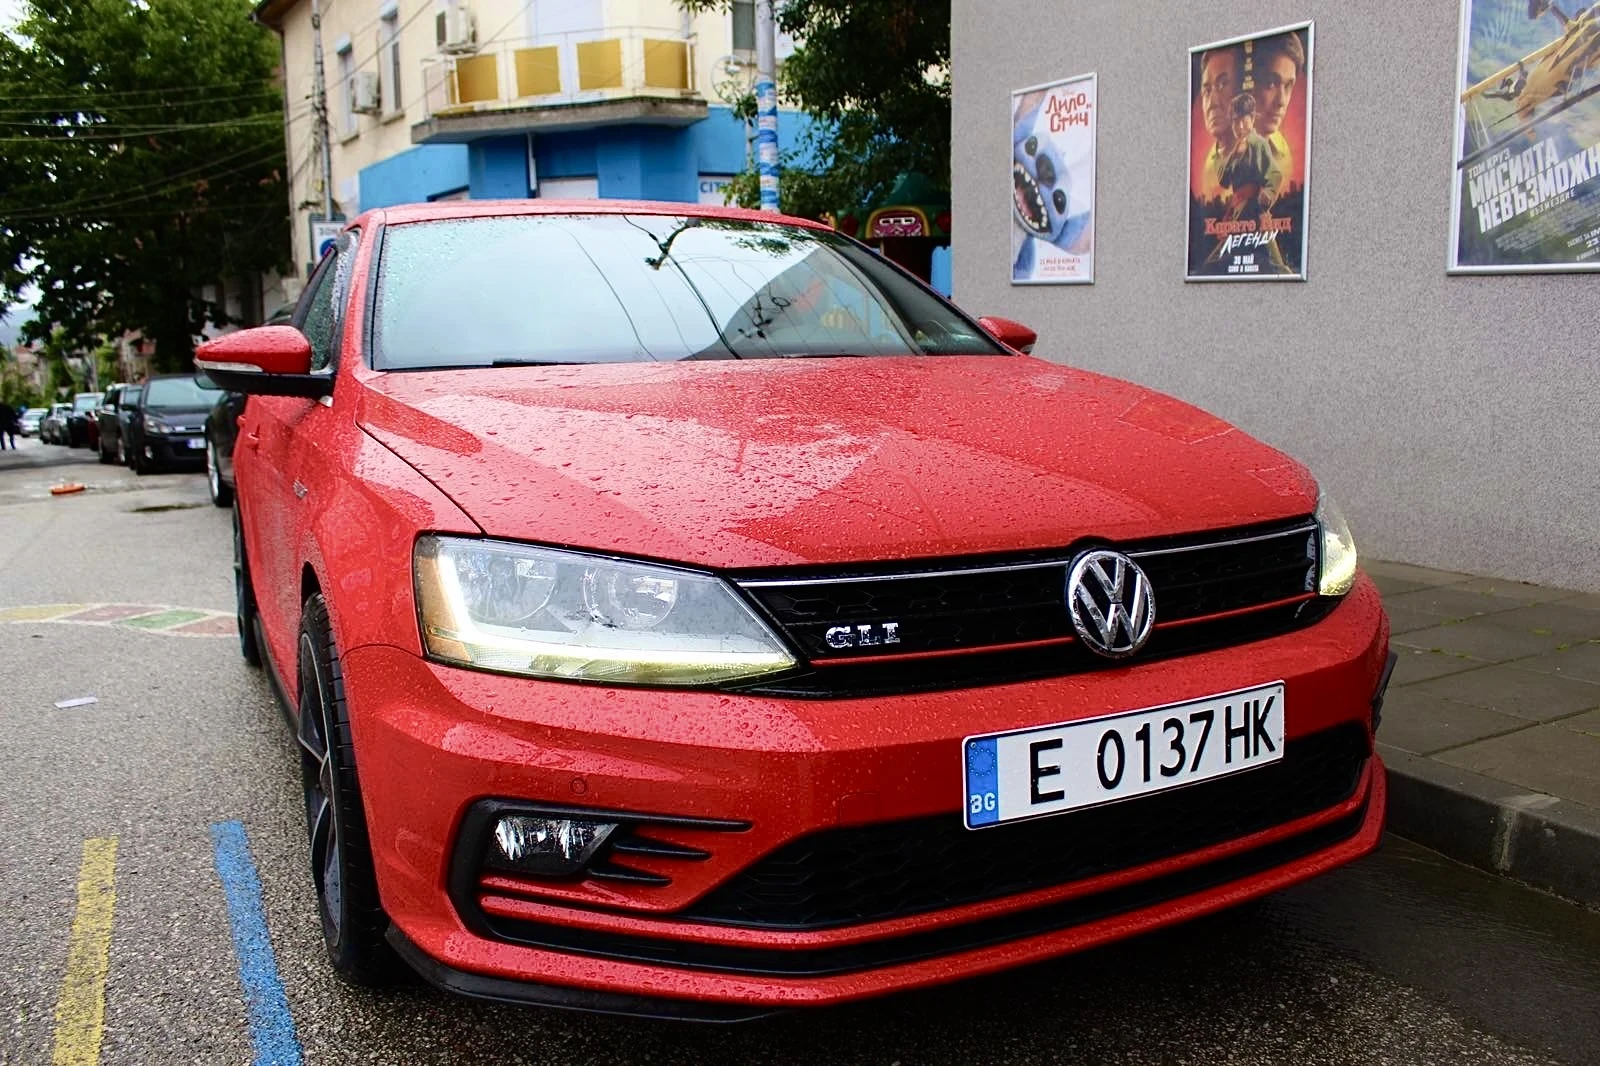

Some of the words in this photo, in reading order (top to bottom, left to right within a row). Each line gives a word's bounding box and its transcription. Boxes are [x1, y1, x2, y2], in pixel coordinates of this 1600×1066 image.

[1469, 136, 1560, 209] МИСИЯТА
[1219, 229, 1279, 258] ЛЕГЕНДИ
[825, 622, 901, 649] GLI
[970, 791, 996, 815] BG
[1029, 738, 1065, 805] E
[1096, 709, 1215, 791] 0137
[1225, 695, 1277, 764] HK
